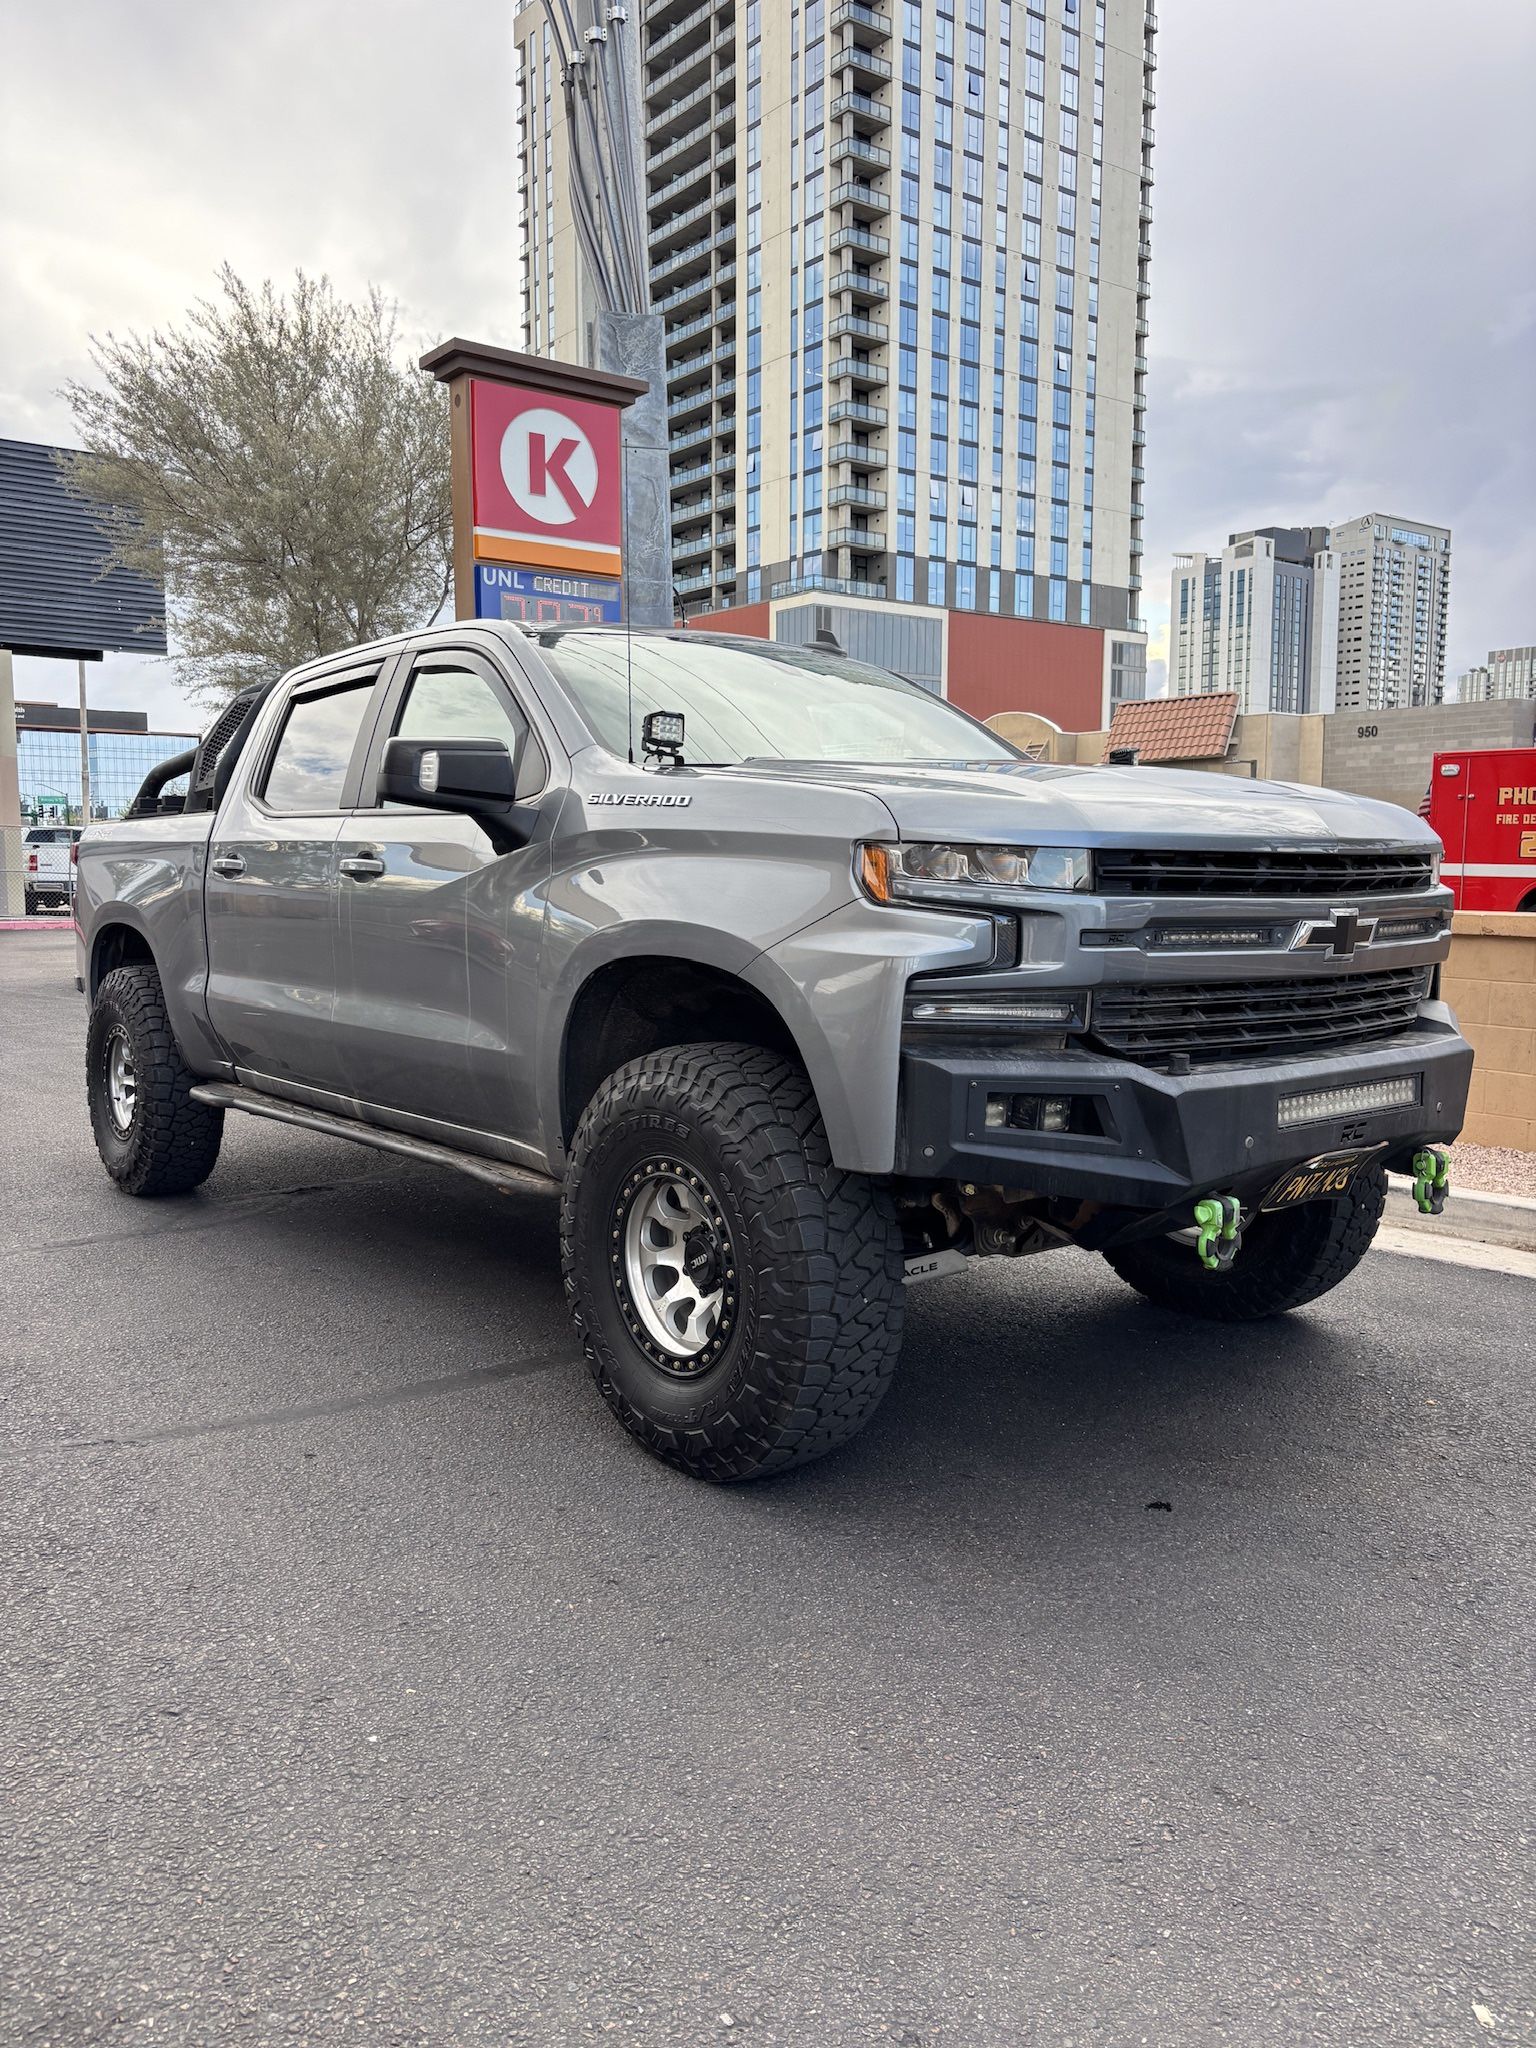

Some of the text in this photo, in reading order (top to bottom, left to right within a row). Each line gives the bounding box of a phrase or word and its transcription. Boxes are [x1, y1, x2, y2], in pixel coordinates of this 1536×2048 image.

[528, 431, 589, 520] K
[483, 567, 589, 598] UNL CREDIT
[1357, 725, 1378, 738] 950
[587, 793, 693, 808] SILVERADO
[1496, 813, 1536, 825] FIRE DE
[628, 1114, 691, 1139] TIRES
